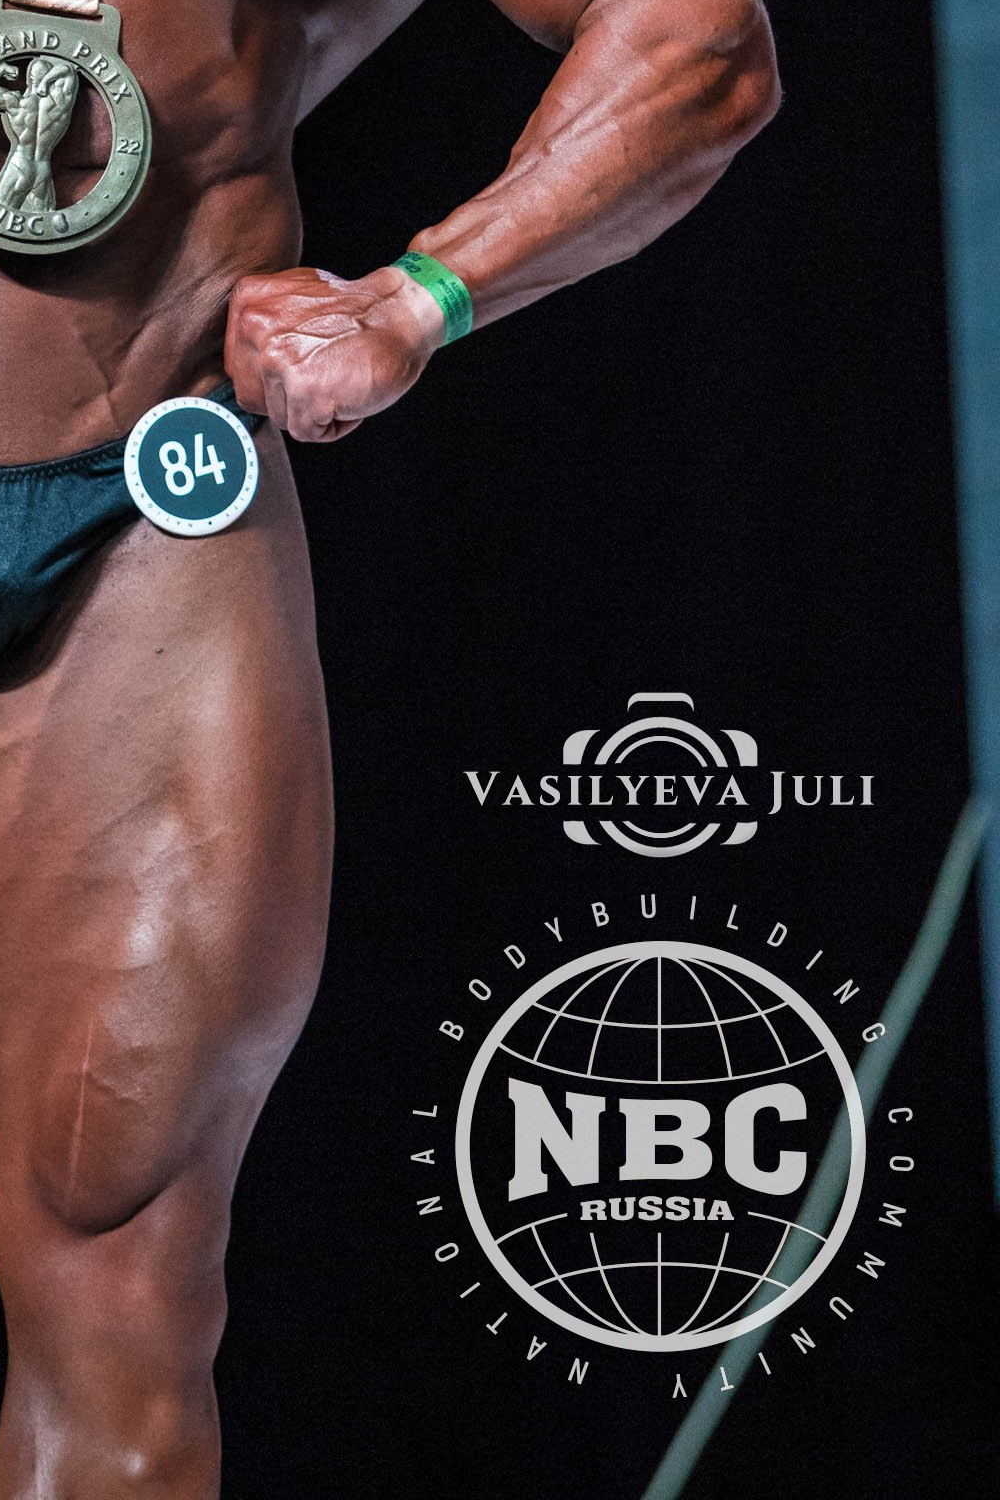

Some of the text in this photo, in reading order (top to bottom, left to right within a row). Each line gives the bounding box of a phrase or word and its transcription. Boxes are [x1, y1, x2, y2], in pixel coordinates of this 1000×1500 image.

[72, 41, 134, 105] PRIX
[116, 137, 142, 156] 22
[158, 432, 227, 497] 84
